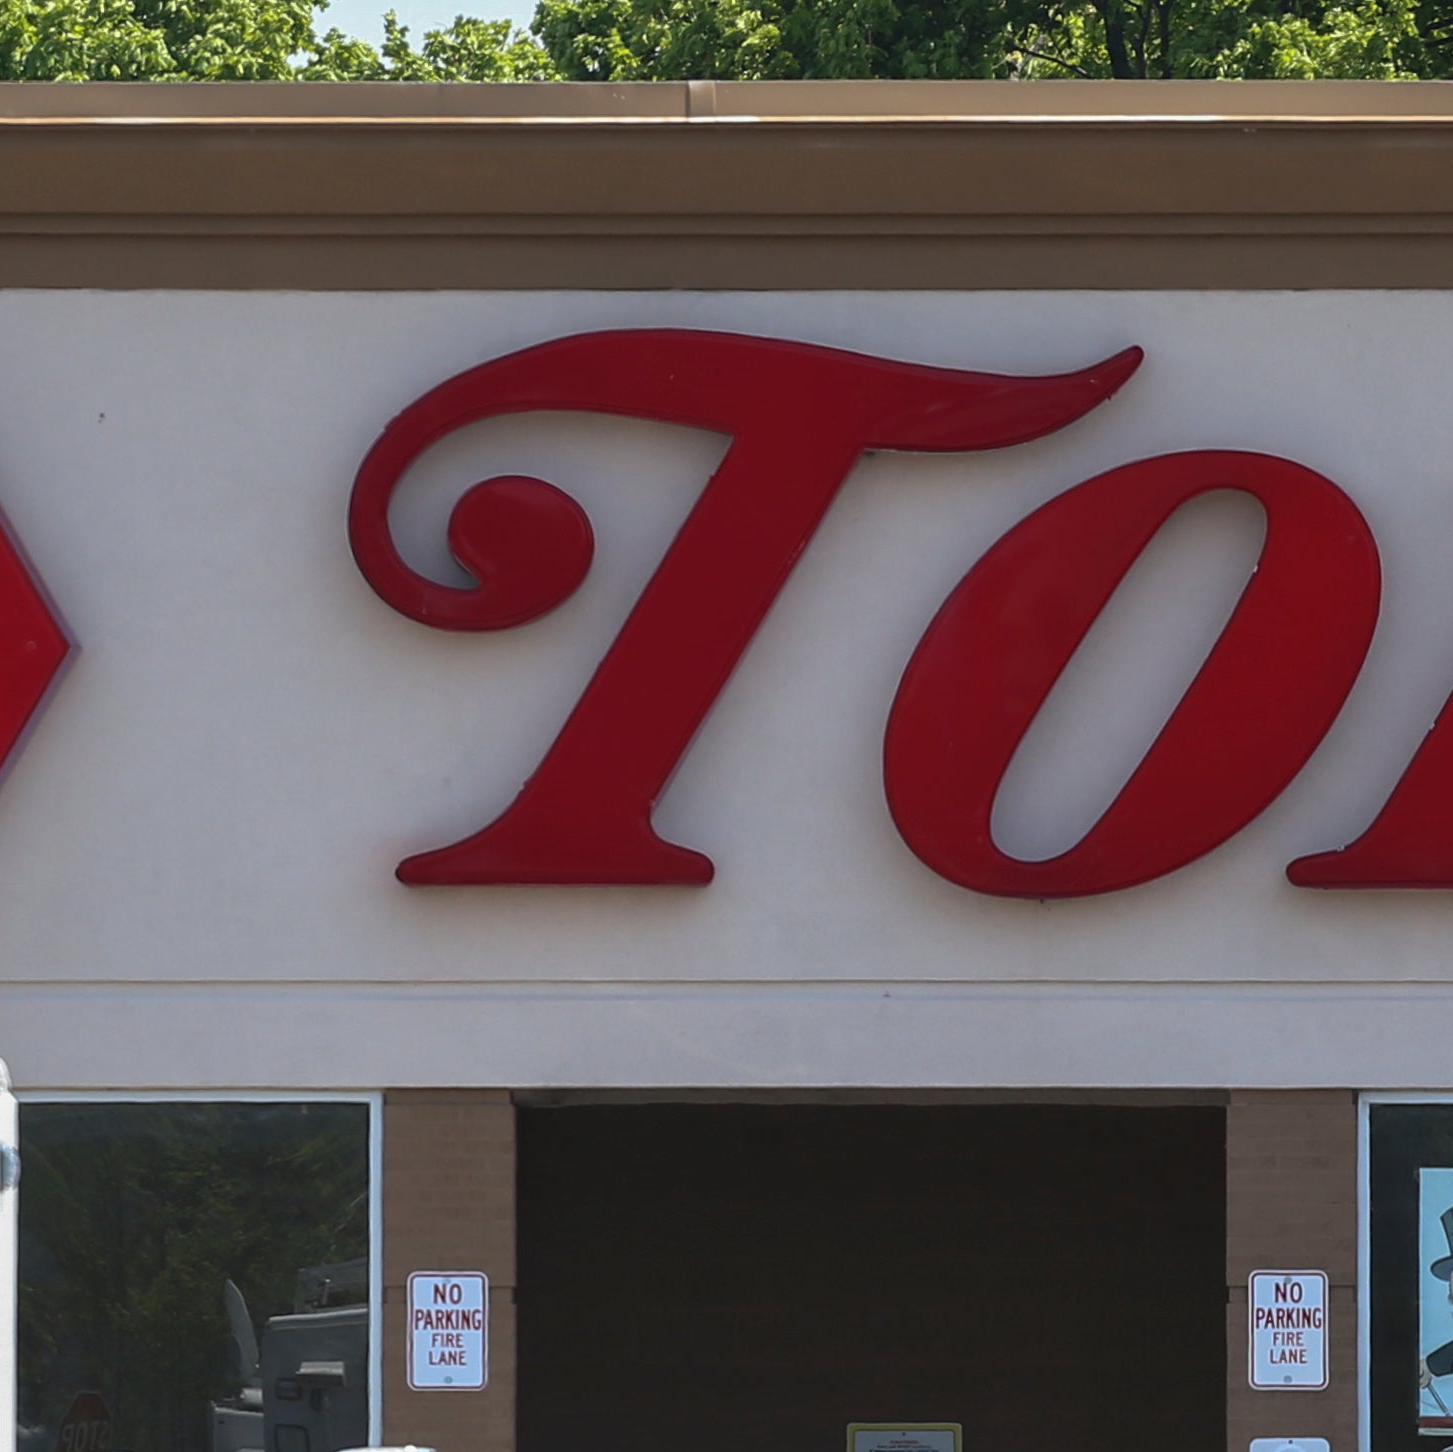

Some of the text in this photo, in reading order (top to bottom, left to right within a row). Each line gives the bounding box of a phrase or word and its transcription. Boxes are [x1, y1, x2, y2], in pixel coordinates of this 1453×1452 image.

[434, 1283, 462, 1305] NO
[1275, 1282, 1303, 1303] NO
[415, 1309, 482, 1330] PARKING
[1256, 1307, 1322, 1329] PARKING
[431, 1333, 464, 1348] FIRE
[1273, 1332, 1304, 1346] FIRE
[428, 1351, 467, 1366] LANE
[1270, 1349, 1308, 1364] LANE
